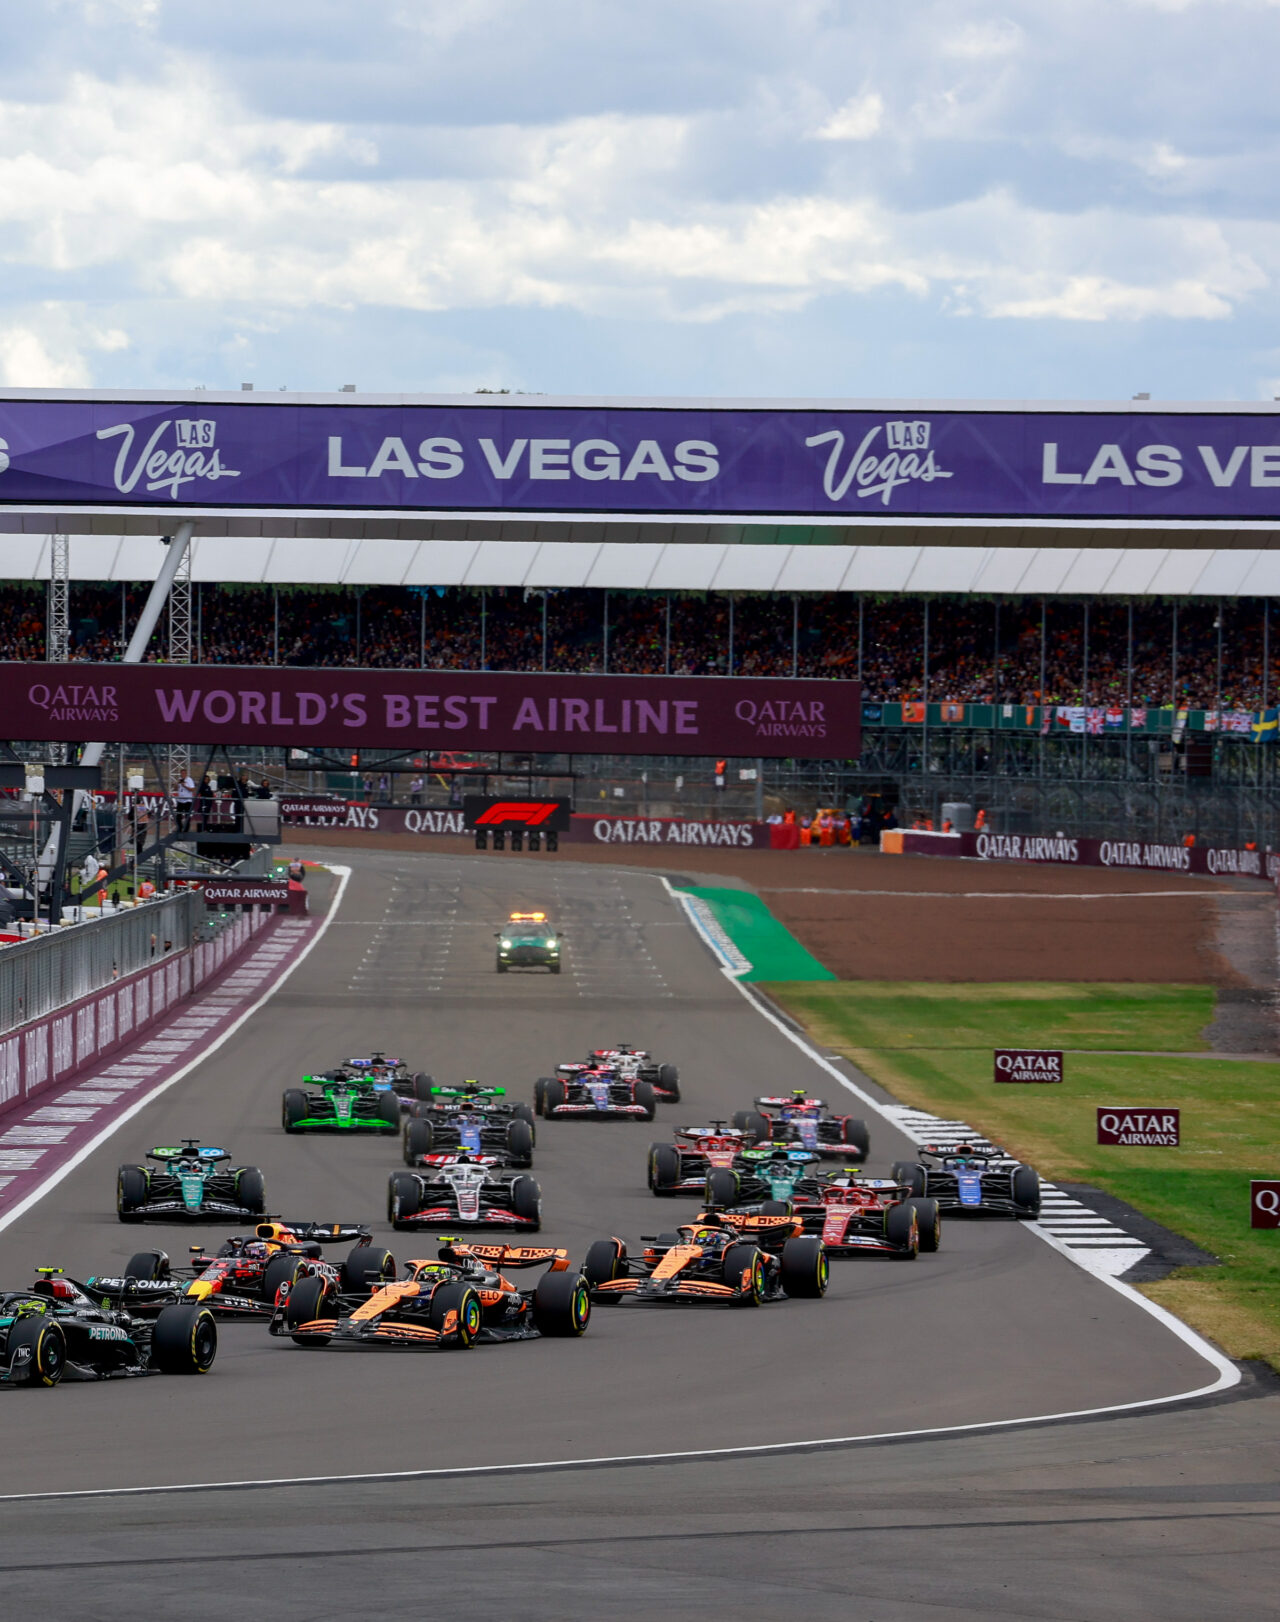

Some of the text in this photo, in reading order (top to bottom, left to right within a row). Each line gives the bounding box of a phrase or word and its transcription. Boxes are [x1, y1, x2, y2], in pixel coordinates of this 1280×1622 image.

[176, 420, 215, 447] LAS
[887, 422, 929, 449] LAS
[97, 420, 241, 500] Vegas
[328, 436, 720, 482] LAS VEGAS
[805, 425, 954, 506] Vegas
[1042, 442, 1183, 487] LAS
[28, 684, 116, 707] QATAR
[49, 706, 119, 722] AIRWAYS
[154, 689, 699, 735] WORLD'S BEST AIRLINE
[734, 699, 826, 724] QATAR
[755, 722, 827, 738] AIRWAYS
[282, 803, 346, 814] QATAR AIRWAYS
[593, 820, 754, 847] QATAR AIRWAYS
[975, 833, 1078, 861] QATAR AIRWAYS
[1099, 841, 1190, 870] QATAR AIRWAYS
[205, 887, 288, 899] QATAR AIRWAYS
[995, 1054, 1059, 1073] QATAR
[1010, 1071, 1061, 1083] AIRWAYS
[1100, 1113, 1176, 1136] QATAR
[1118, 1133, 1177, 1146] AIRWAYS
[89, 1327, 130, 1341] PETRONAS
[17, 1347, 31, 1358] IWC
